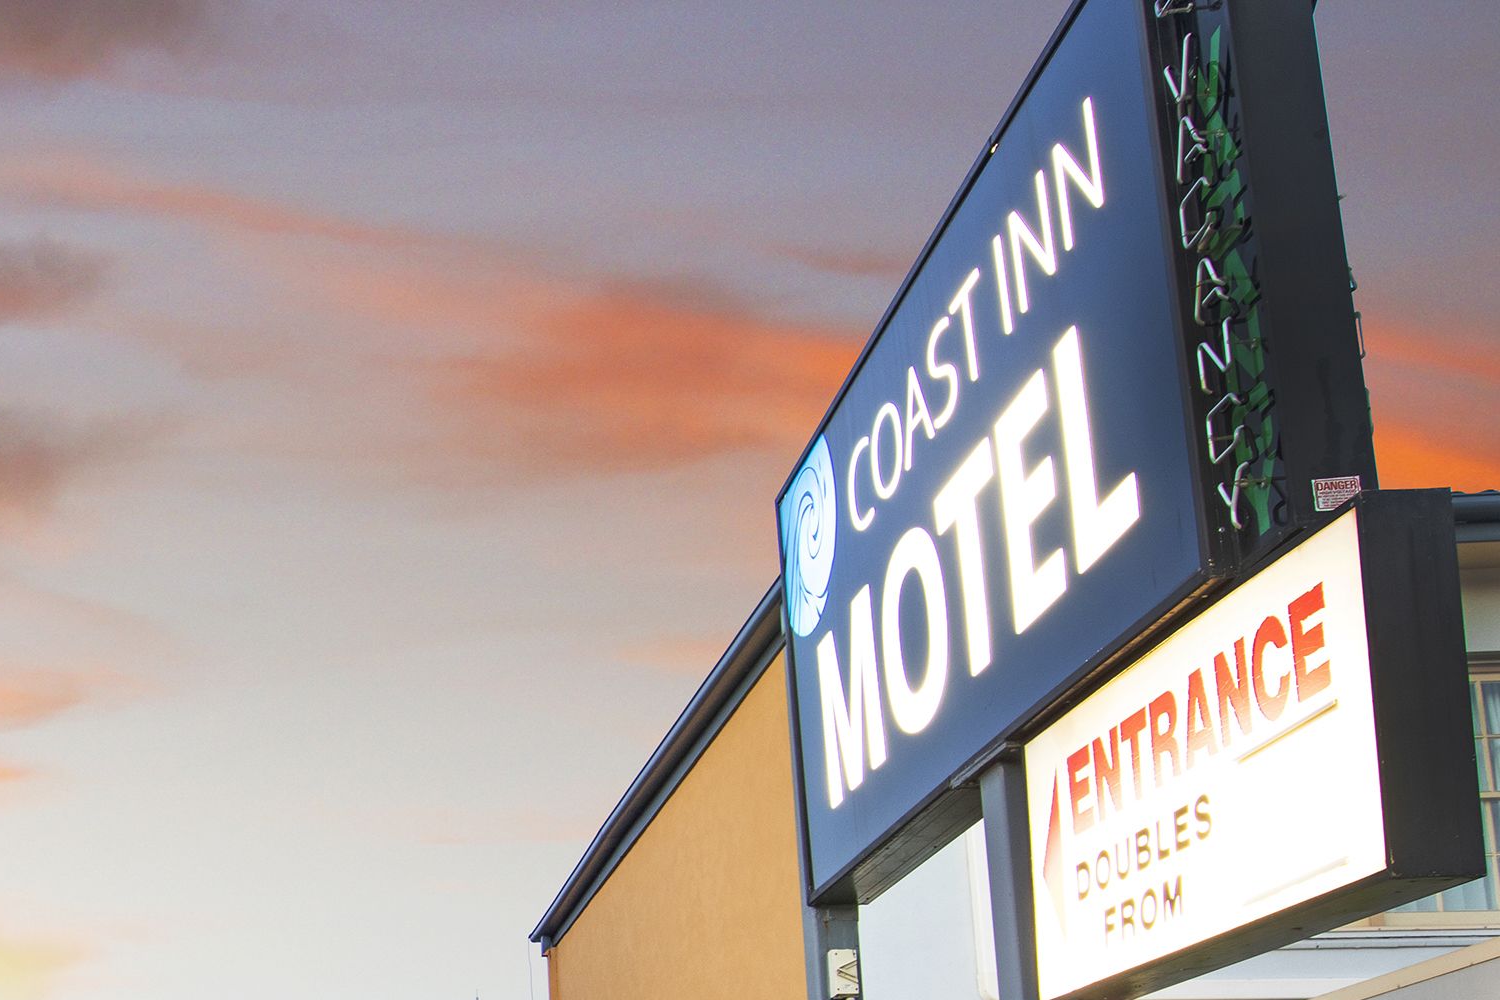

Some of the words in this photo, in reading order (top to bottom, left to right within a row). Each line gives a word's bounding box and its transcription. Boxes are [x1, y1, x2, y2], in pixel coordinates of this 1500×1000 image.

[847, 267, 980, 532] COAST
[993, 96, 1105, 335] INN
[816, 325, 1142, 811] MOTEL
[1316, 480, 1357, 491] DANGER
[1066, 580, 1332, 836] ENTRANCE
[1075, 793, 1212, 900] DOUBLES
[1104, 874, 1183, 949] FROM
